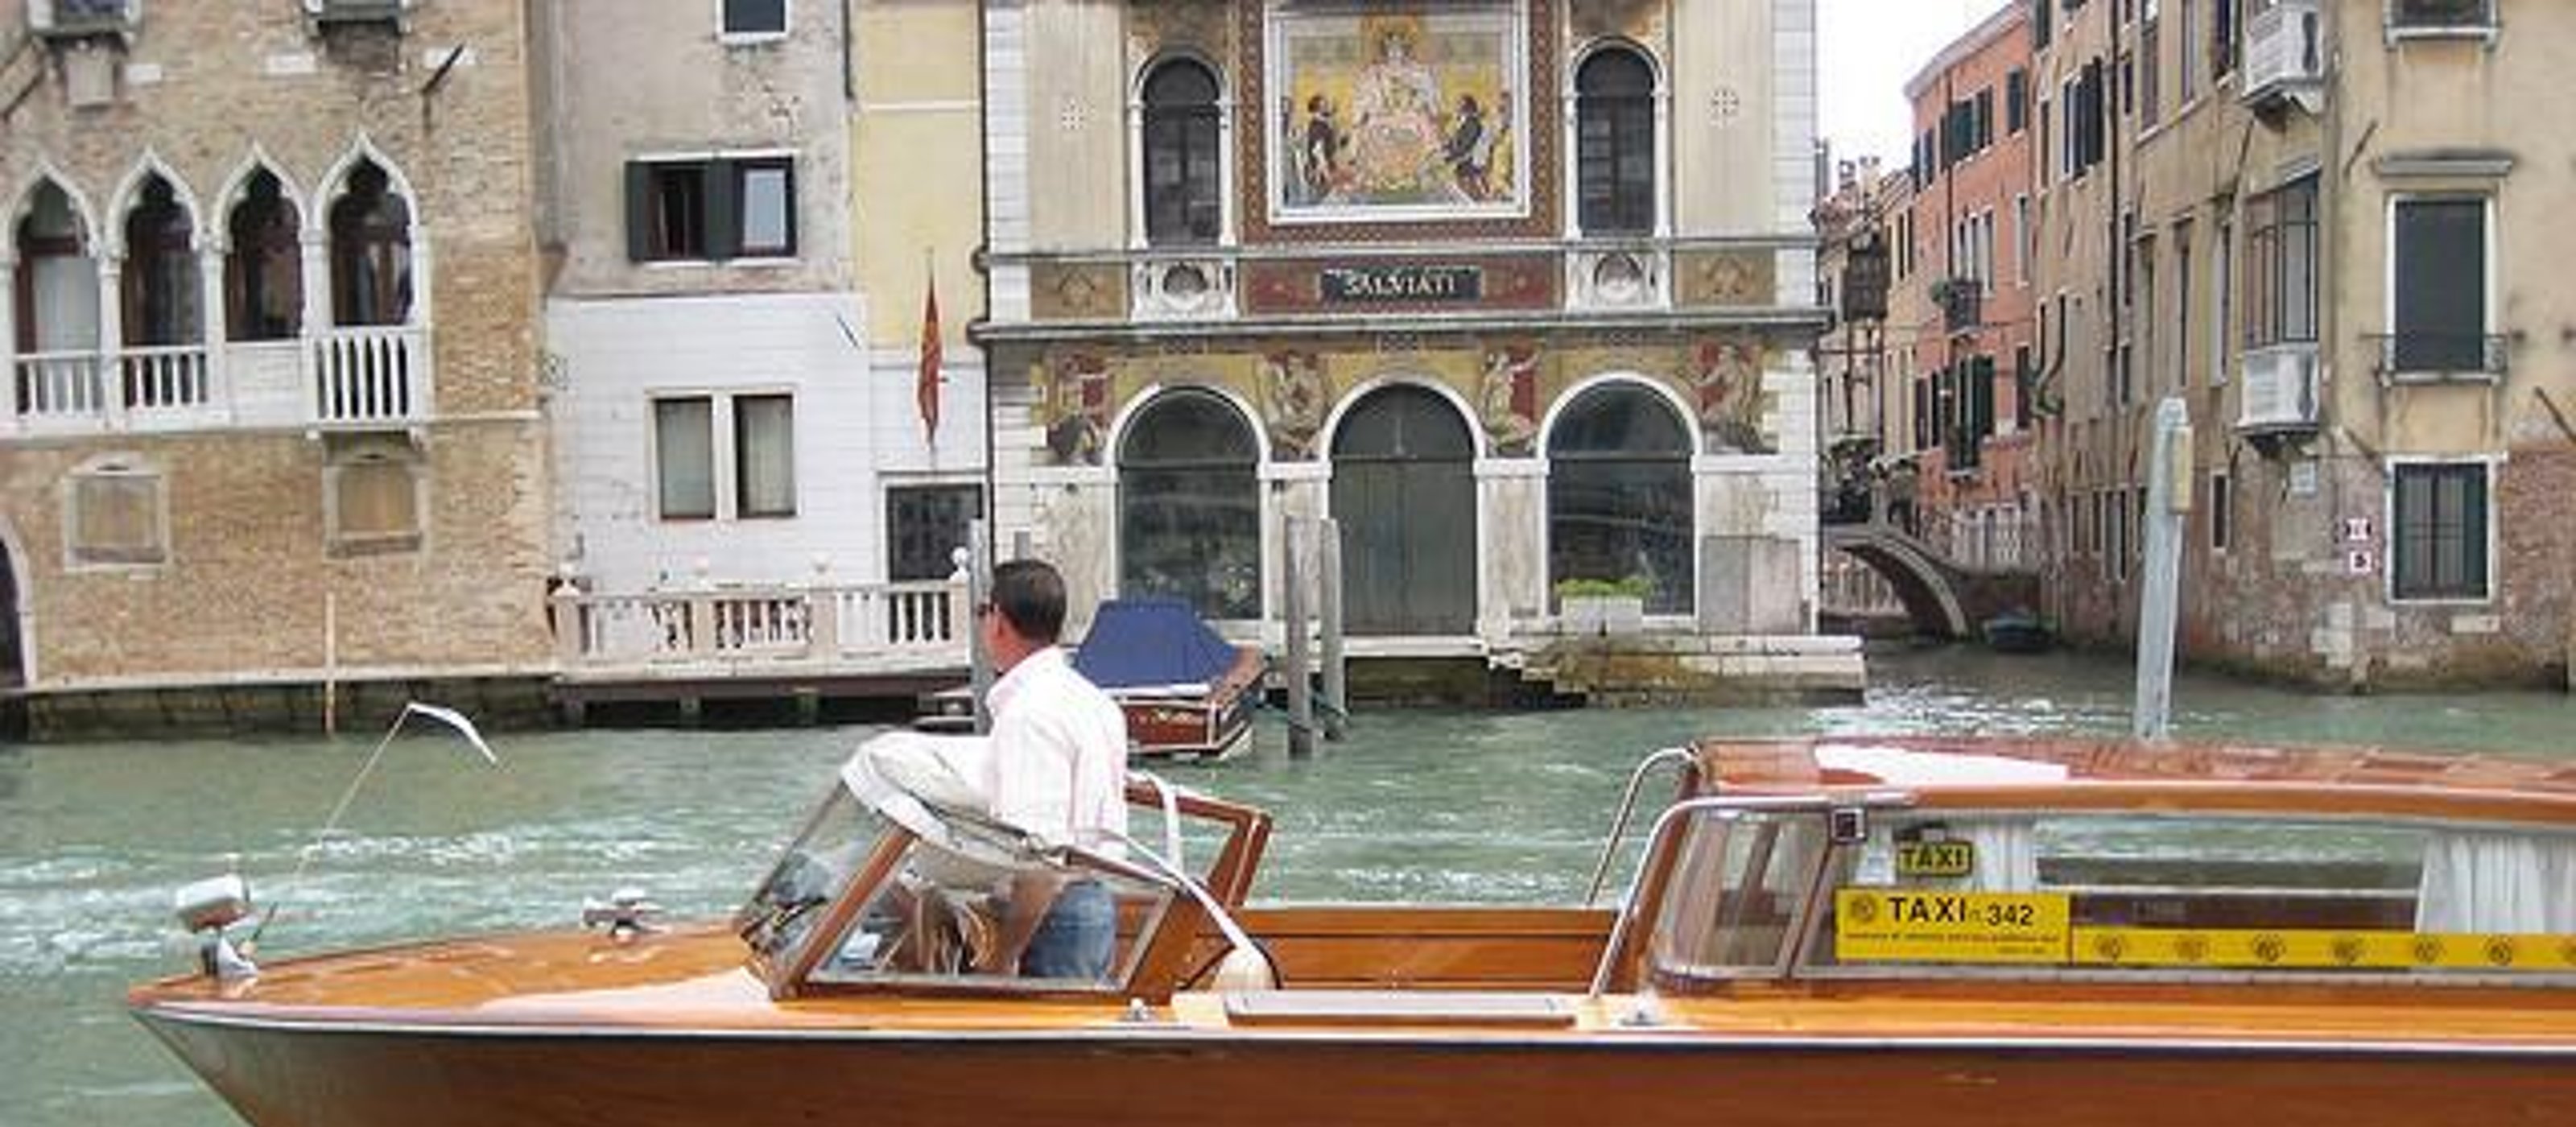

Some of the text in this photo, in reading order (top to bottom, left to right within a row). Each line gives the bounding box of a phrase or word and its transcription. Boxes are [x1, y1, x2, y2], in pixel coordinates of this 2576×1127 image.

[1344, 274, 1455, 295] SALVIATI
[1900, 848, 1963, 868] TAXI
[1888, 897, 1966, 923] TAXI
[1987, 903, 2034, 927] 342
